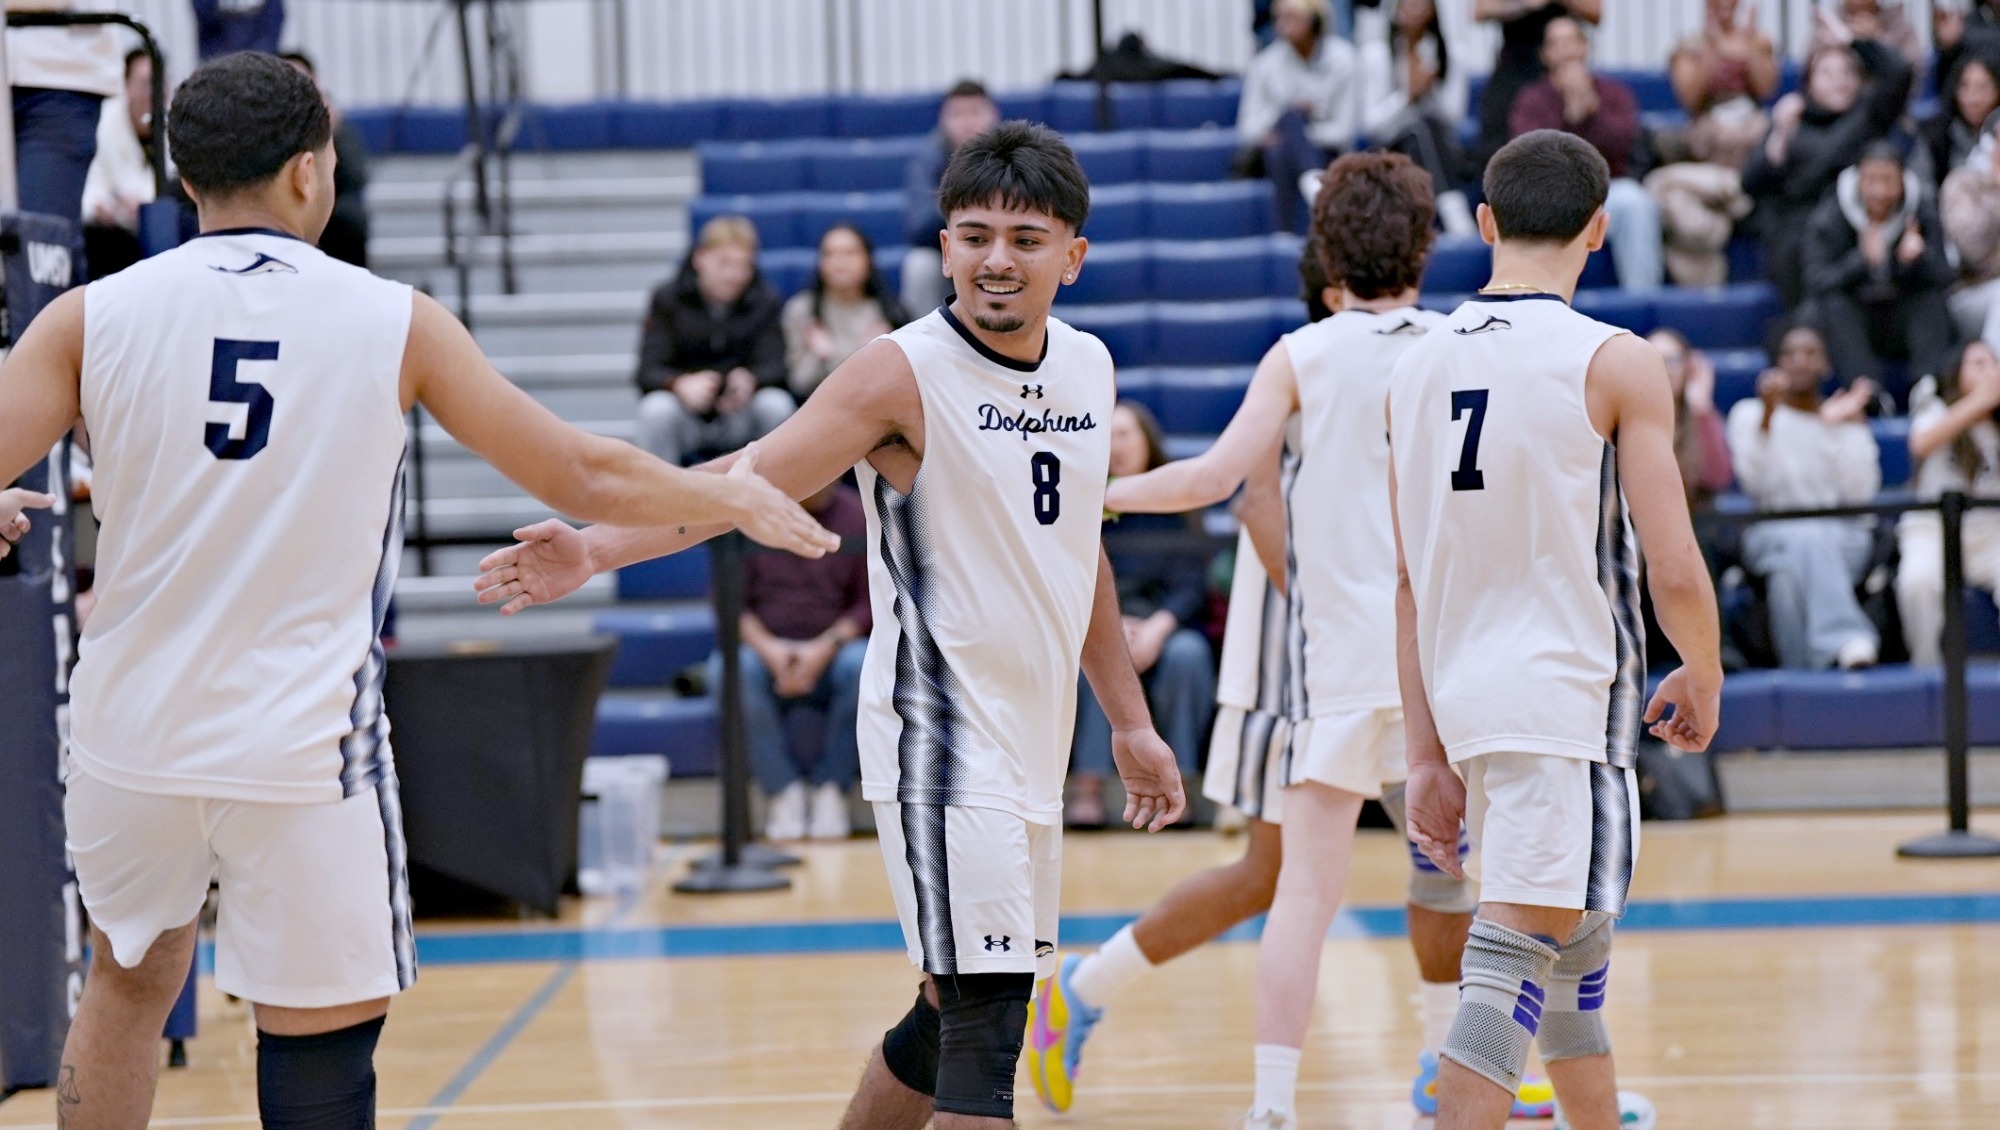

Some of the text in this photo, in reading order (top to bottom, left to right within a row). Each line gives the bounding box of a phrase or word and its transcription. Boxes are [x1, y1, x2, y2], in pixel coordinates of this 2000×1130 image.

[204, 337, 280, 460] 5
[978, 403, 1096, 441] Dolphins
[1451, 389, 1489, 491] 7
[1031, 451, 1060, 525] 8
